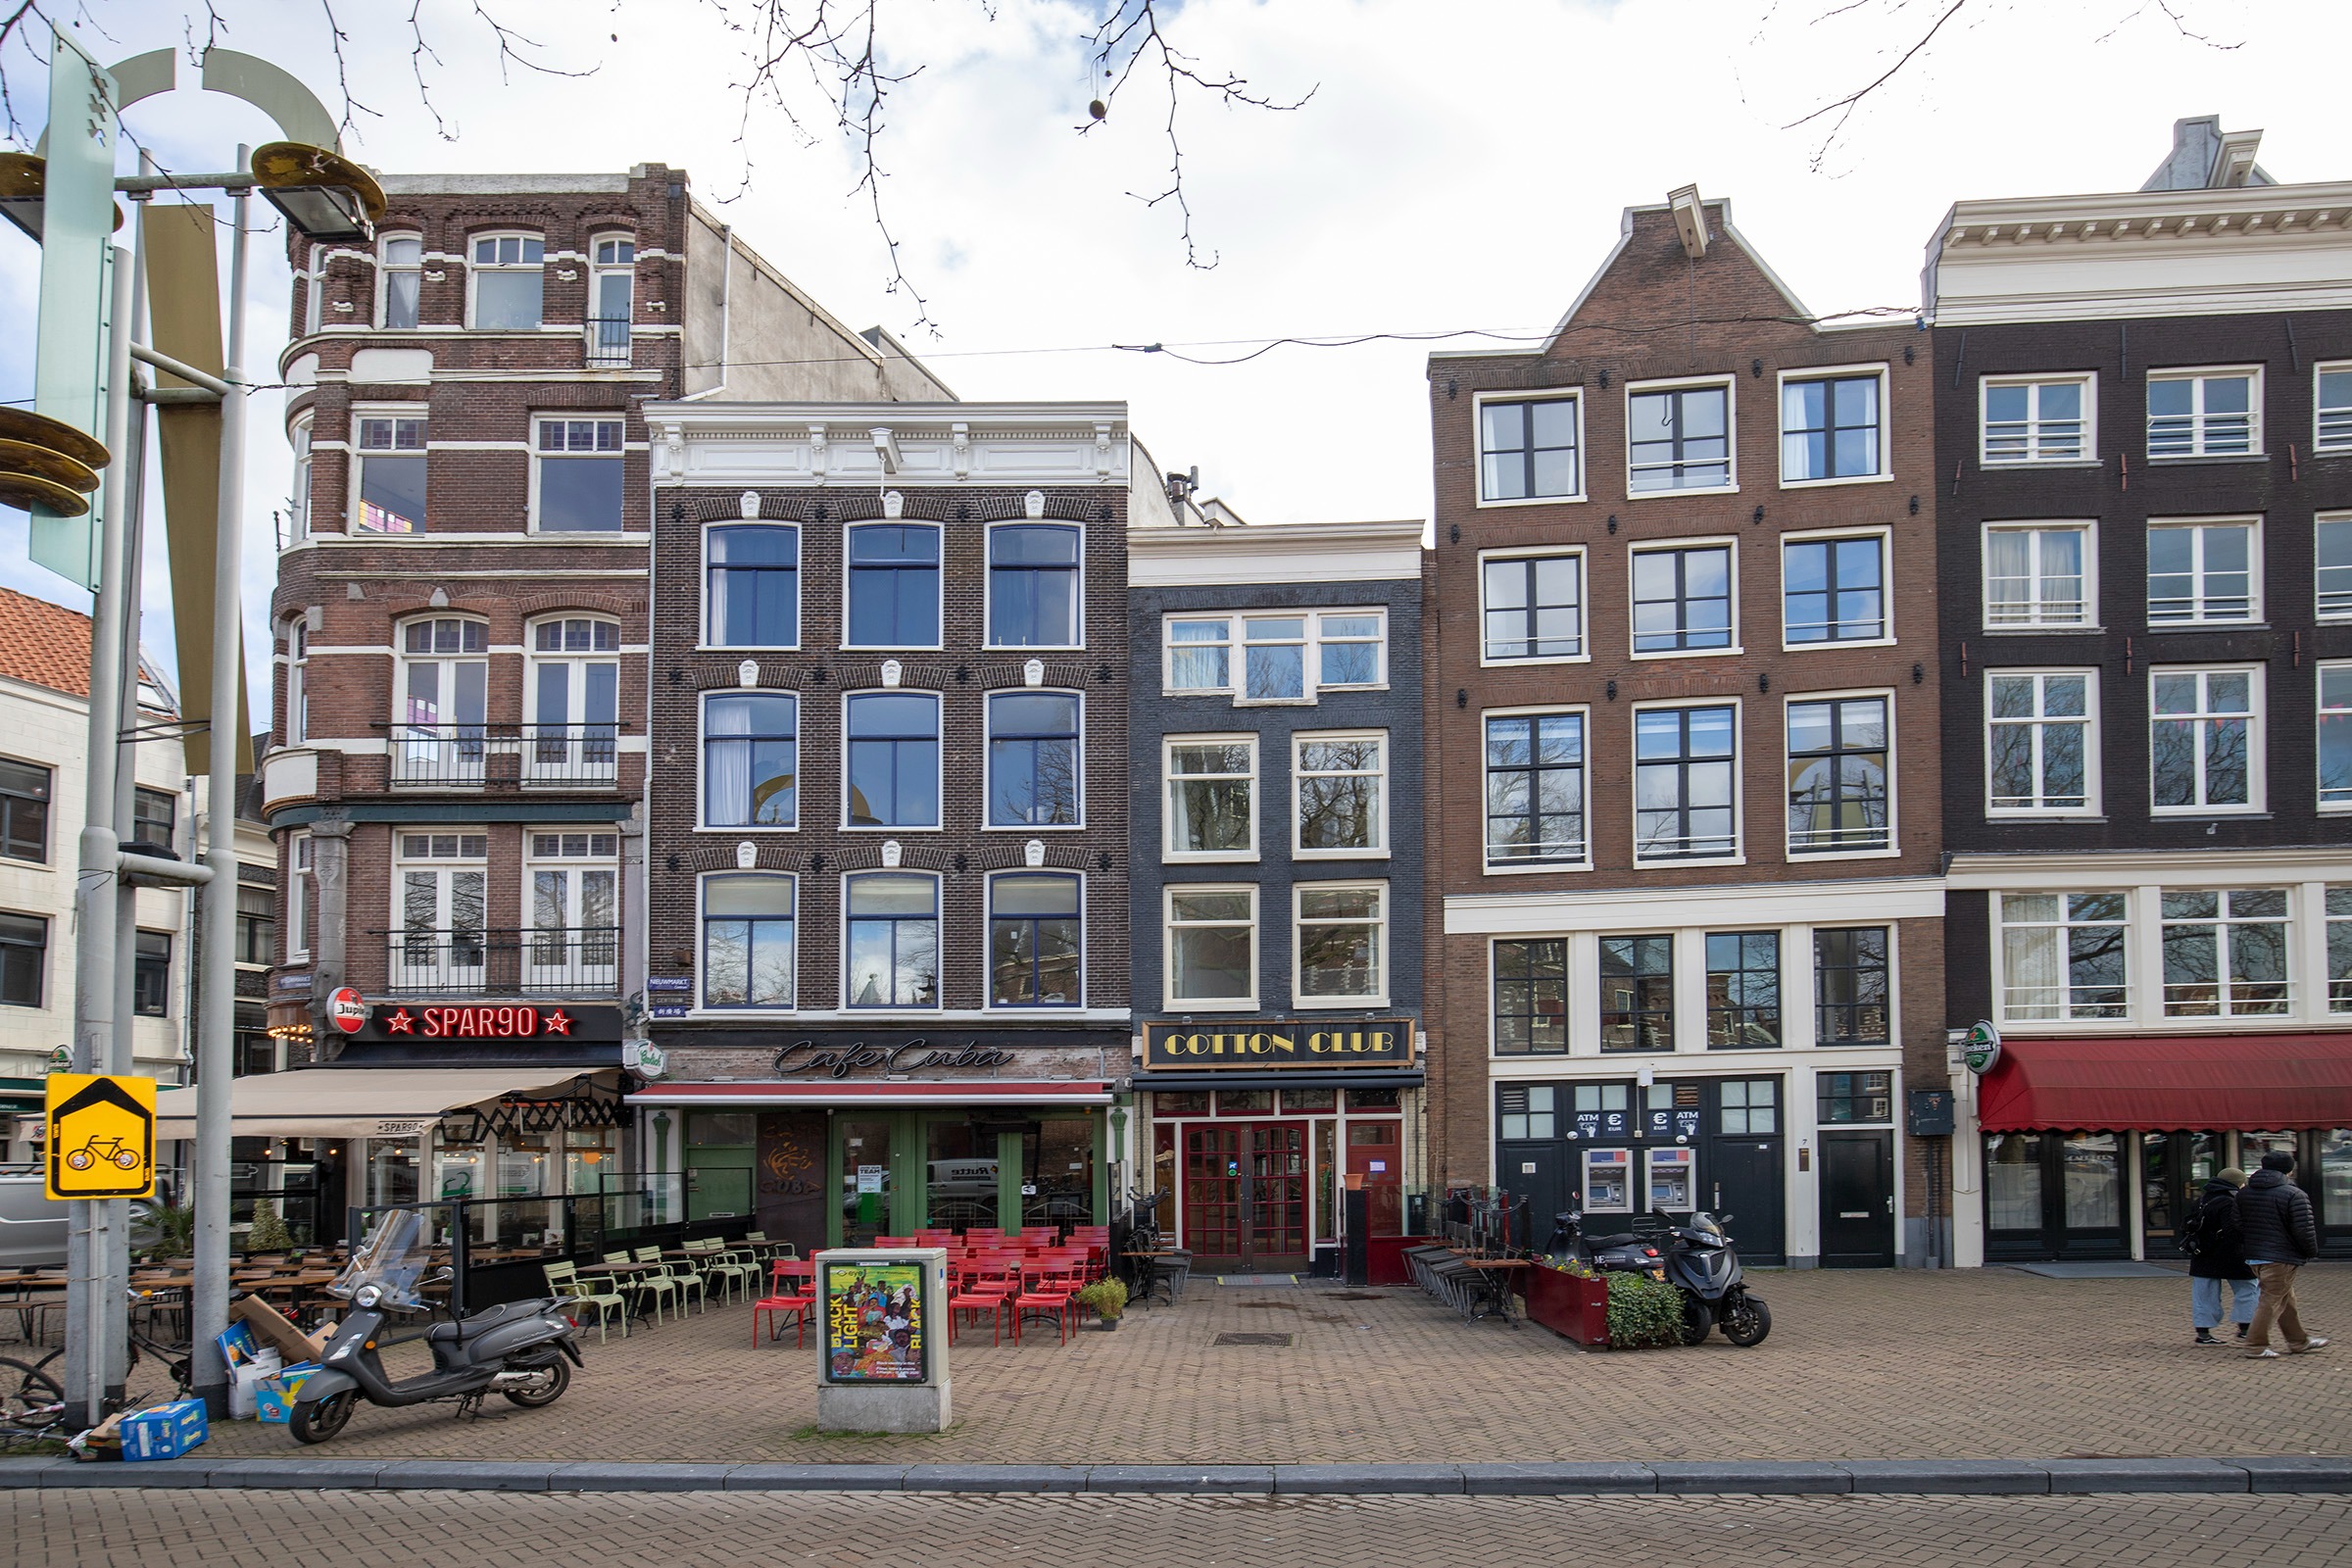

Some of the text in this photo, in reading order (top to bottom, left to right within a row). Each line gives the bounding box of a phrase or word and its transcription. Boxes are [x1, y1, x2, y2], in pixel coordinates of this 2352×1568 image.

[422, 1007, 538, 1037] SPAR90
[771, 1038, 1014, 1078] Cafe Cuba
[1164, 1032, 1394, 1054] COTTON CLUB
[383, 1122, 418, 1132] SPAR90
[830, 1298, 842, 1348] BLACK
[844, 1304, 858, 1348] LIGHT
